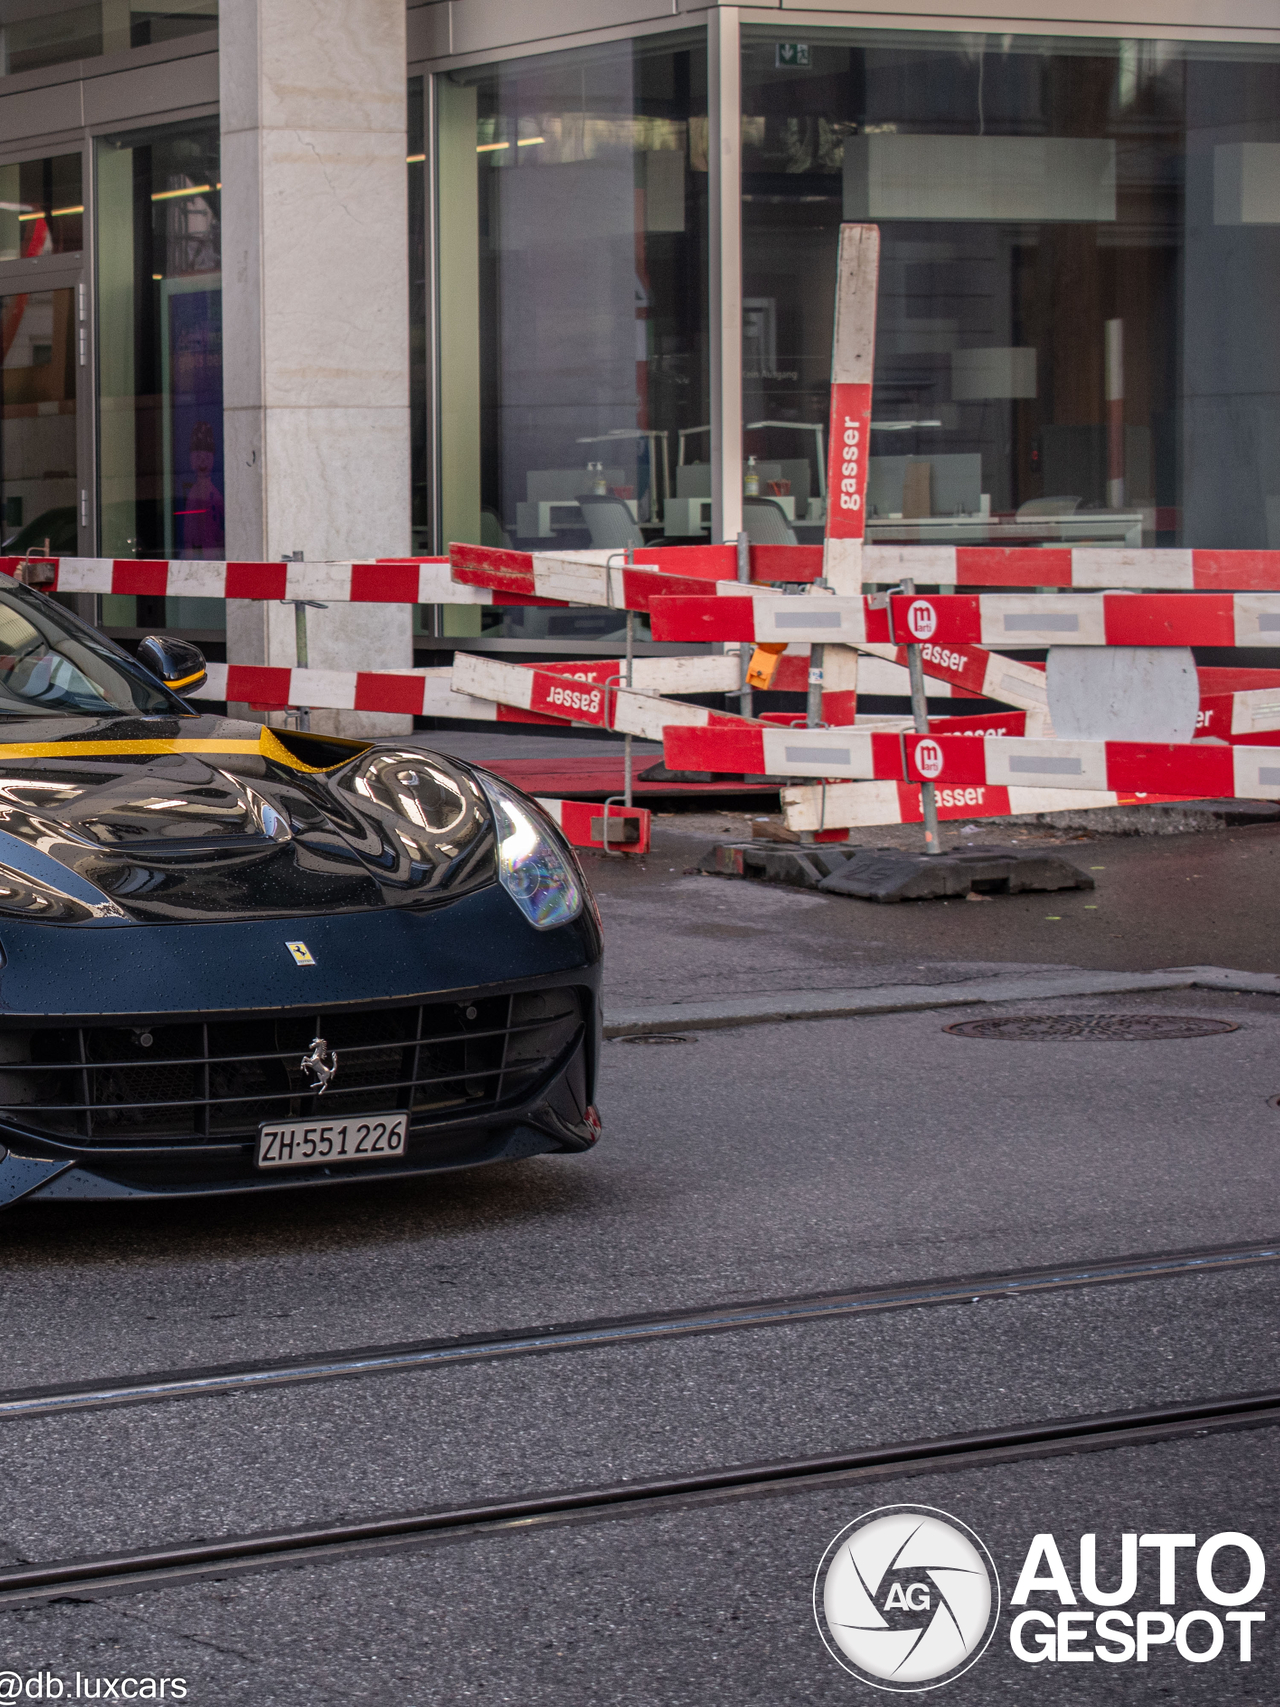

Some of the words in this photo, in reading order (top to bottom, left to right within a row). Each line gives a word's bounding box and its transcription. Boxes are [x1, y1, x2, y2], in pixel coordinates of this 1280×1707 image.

[839, 416, 860, 511] gasser
[920, 643, 968, 673] asser
[546, 686, 601, 713] gasser
